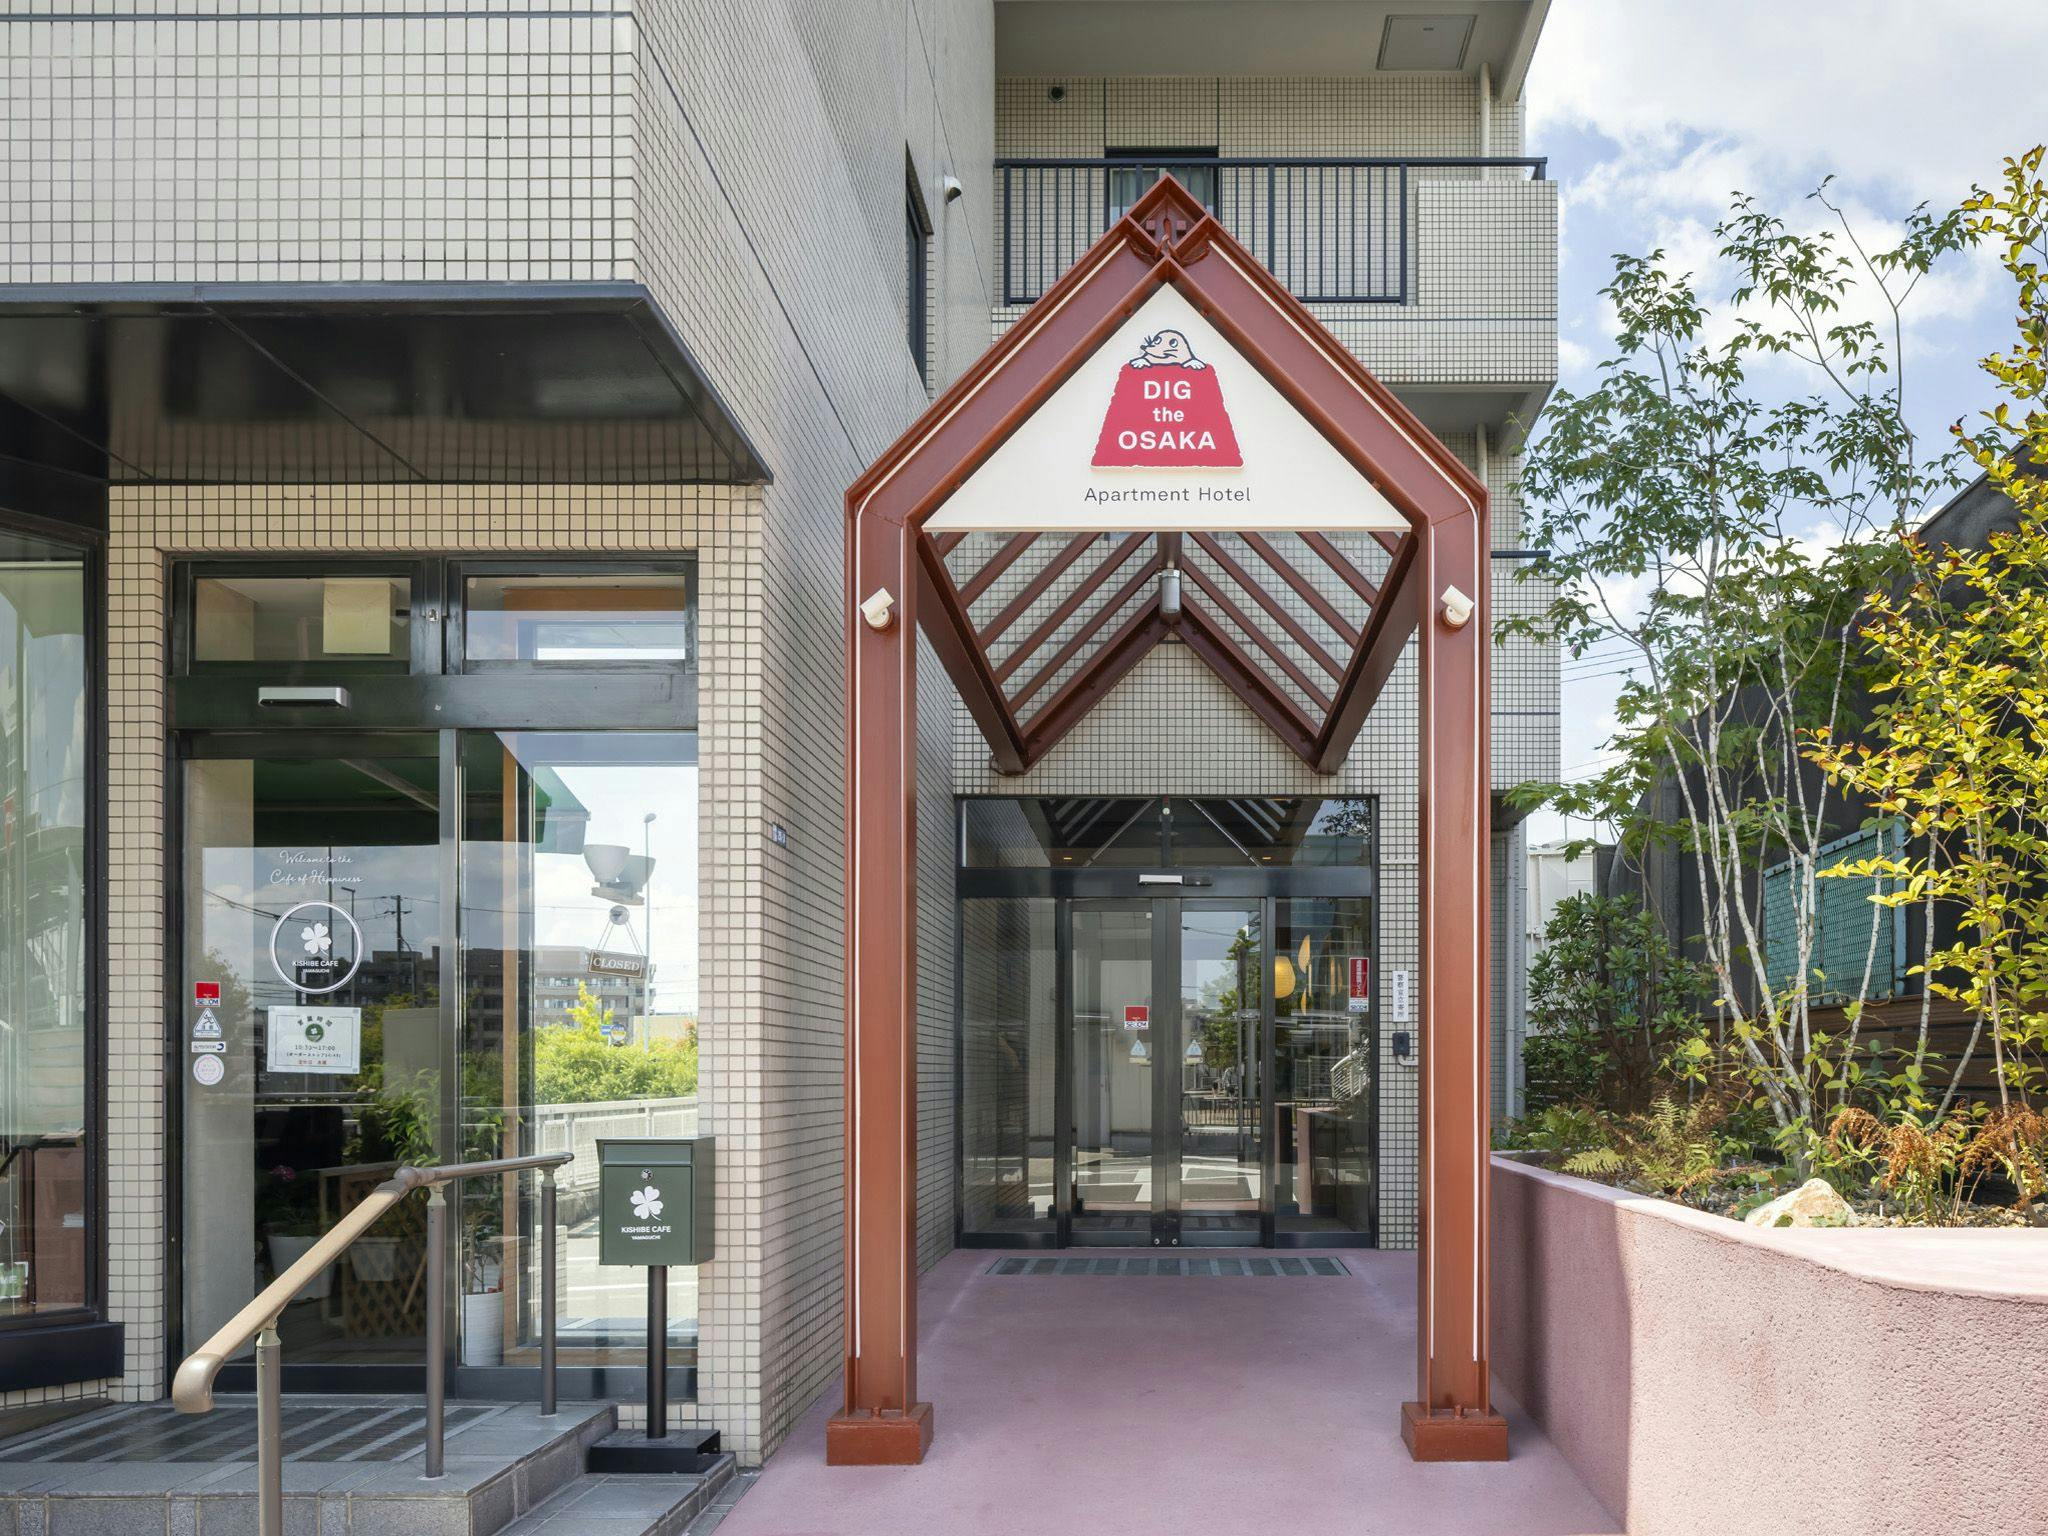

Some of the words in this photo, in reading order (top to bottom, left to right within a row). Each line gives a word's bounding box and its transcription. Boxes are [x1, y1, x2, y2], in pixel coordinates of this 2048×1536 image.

[1143, 380, 1192, 400] DIG
[1152, 406, 1185, 422] the
[1117, 430, 1217, 450] OSAKA
[1084, 487, 1190, 505] Apartment
[1199, 487, 1251, 502] Hotel
[280, 850, 324, 865] Welcome
[324, 856, 336, 864] to
[337, 855, 353, 864] the
[297, 873, 308, 885] of
[308, 869, 364, 885] Happiness
[592, 957, 640, 971] CLOSED
[651, 1225, 672, 1233] CAFE
